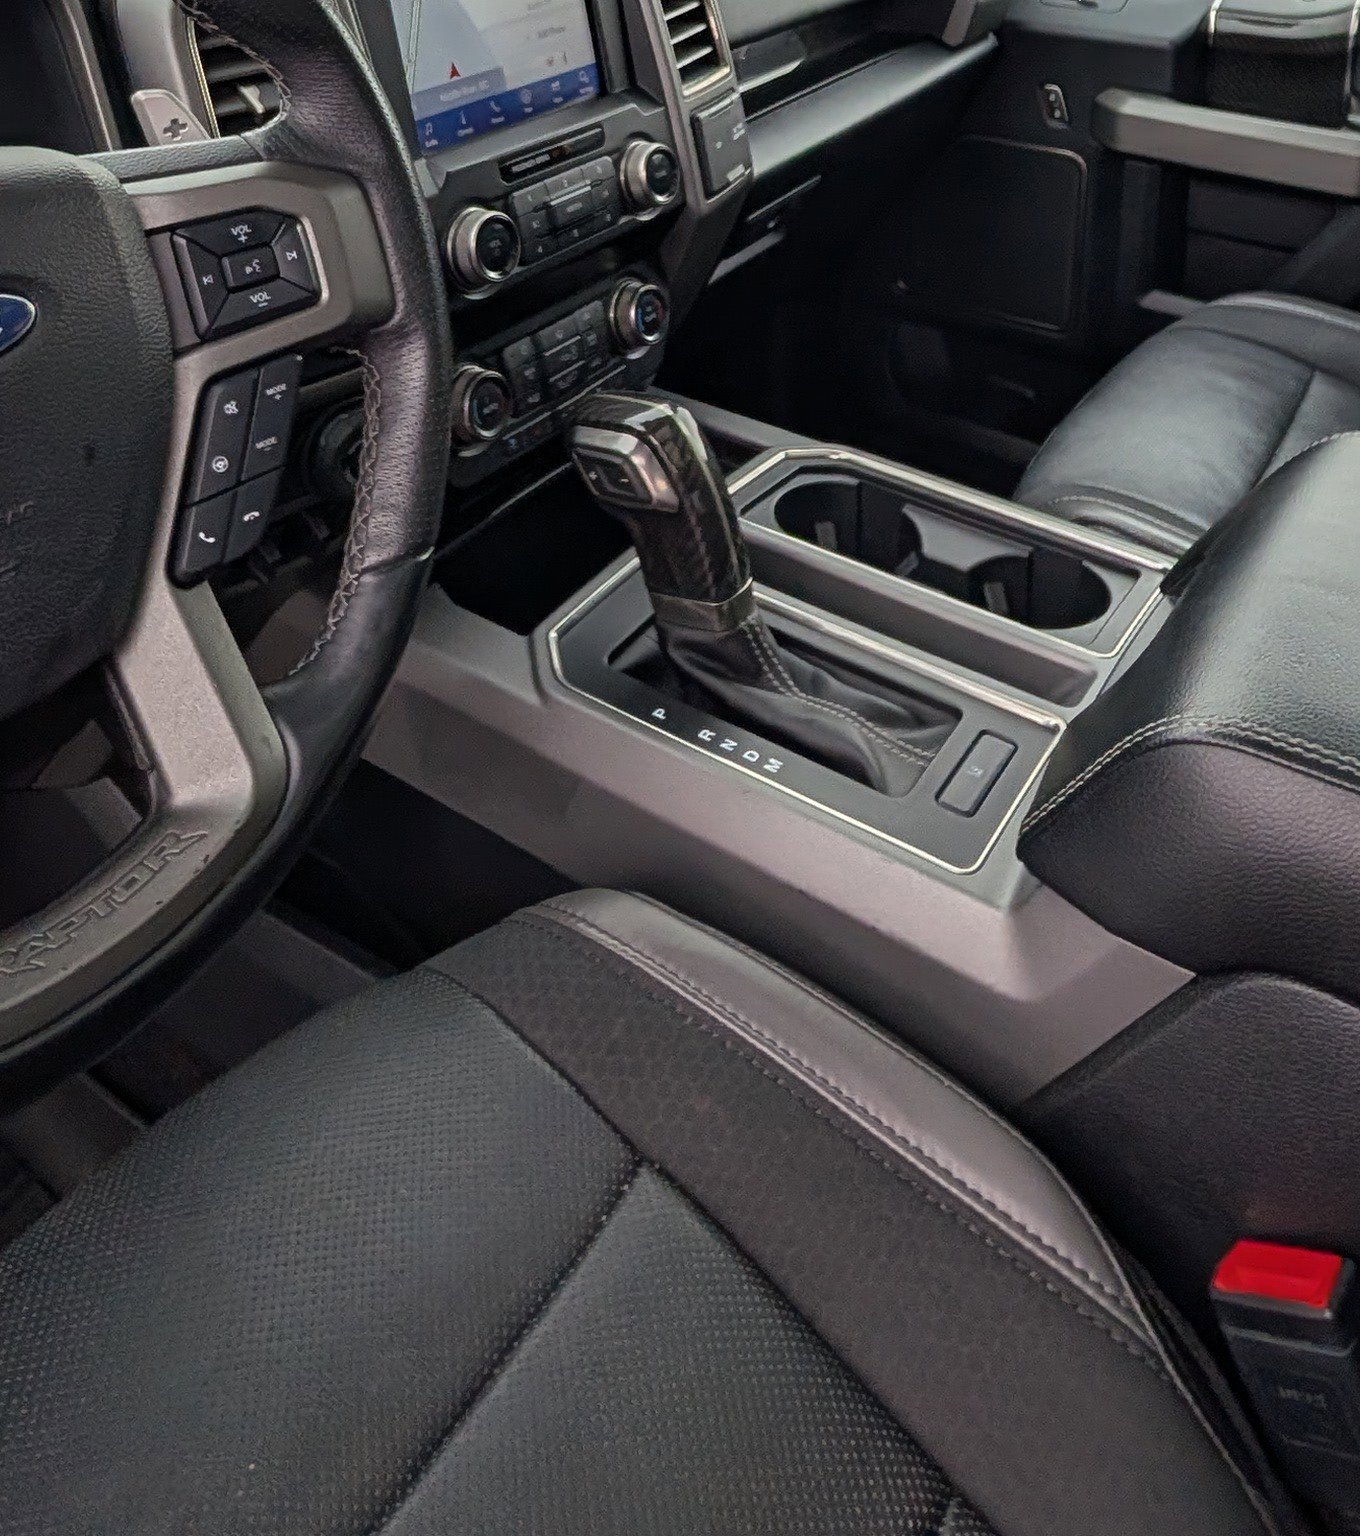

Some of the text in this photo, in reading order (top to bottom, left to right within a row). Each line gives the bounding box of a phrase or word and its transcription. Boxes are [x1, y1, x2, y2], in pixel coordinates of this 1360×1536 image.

[231, 224, 252, 236] VOL
[250, 291, 271, 304] VOL
[651, 707, 667, 720] P
[698, 728, 784, 773] R N D M
